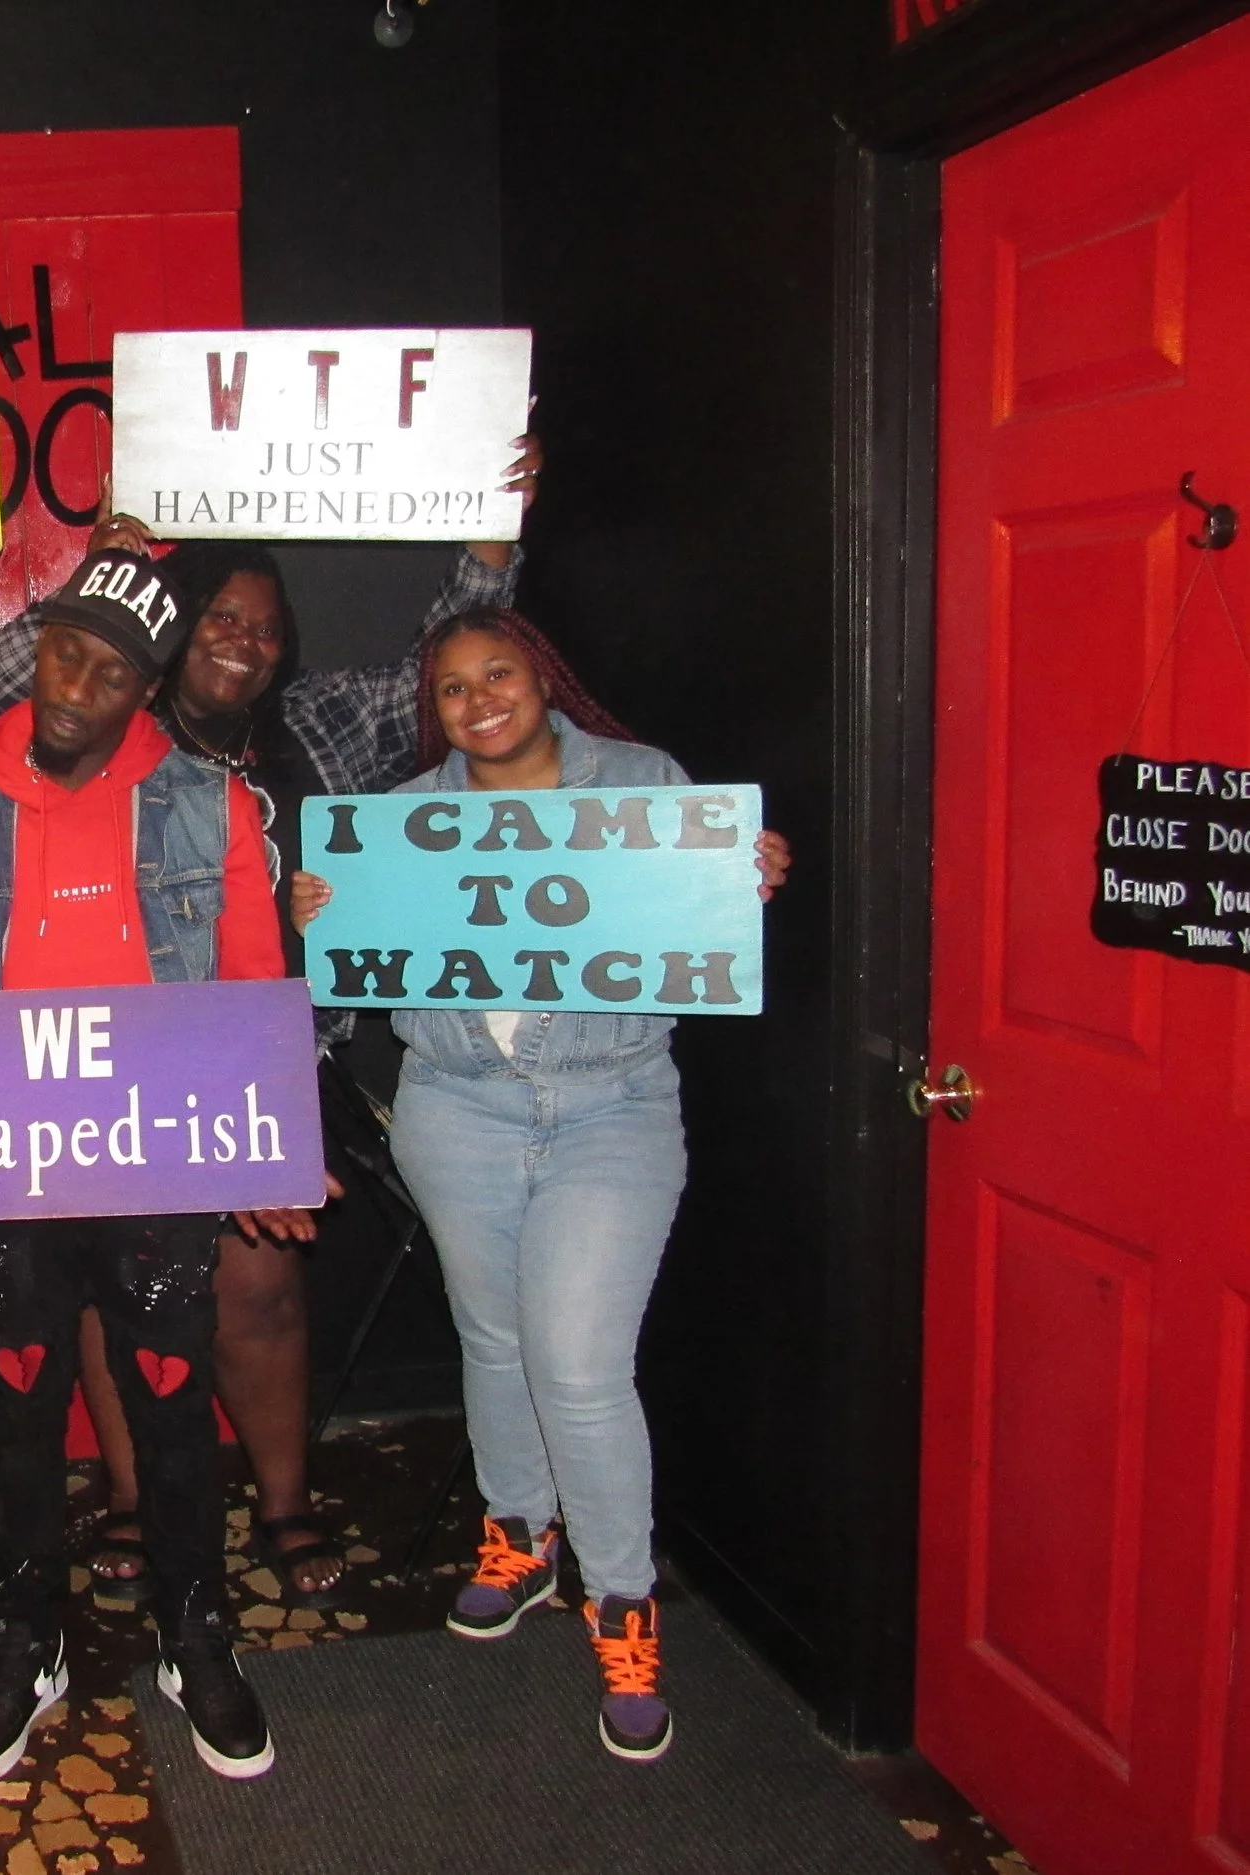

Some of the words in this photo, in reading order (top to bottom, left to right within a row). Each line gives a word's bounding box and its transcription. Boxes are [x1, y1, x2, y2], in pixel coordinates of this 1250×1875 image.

[259, 442, 374, 476] JUST
[152, 490, 484, 525] HAPPENED?!?!
[1137, 763, 1250, 800] PLEASE
[325, 804, 363, 854] I
[404, 793, 738, 852] CAME
[1107, 813, 1188, 849] CLOSE
[458, 874, 591, 927] TO
[324, 948, 742, 1005] WATCH
[20, 1006, 113, 1080] WE
